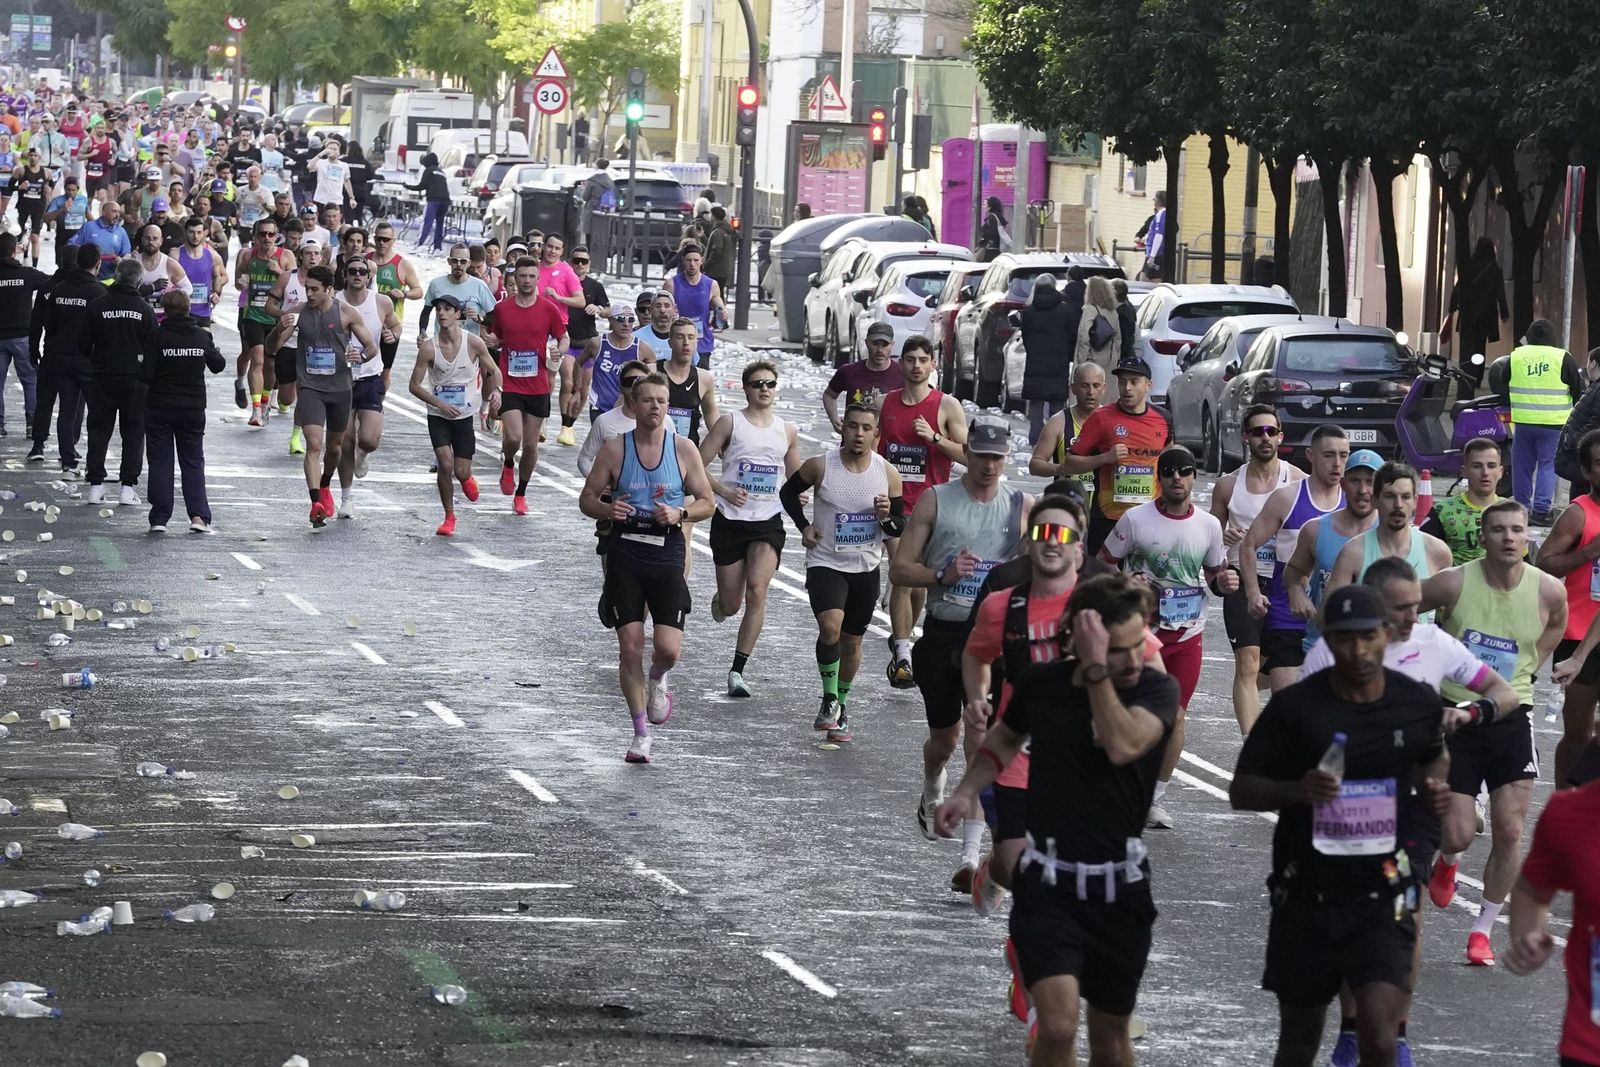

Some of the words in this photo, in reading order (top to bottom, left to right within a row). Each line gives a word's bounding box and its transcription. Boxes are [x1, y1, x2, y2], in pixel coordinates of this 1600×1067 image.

[540, 90, 561, 103] 30
[0, 278, 25, 287] UNTEER
[55, 296, 87, 307] VOLUNTEER
[102, 310, 143, 321] VOLUNTEER
[162, 348, 205, 357] VOLUNTEER
[1527, 362, 1550, 377] Life
[1354, 431, 1374, 441] GBR
[1478, 427, 1497, 436] cabify
[899, 446, 923, 454] ZURICH
[736, 482, 752, 492] SAM
[753, 483, 777, 494] MACEY
[1117, 485, 1151, 495] CHARLES
[1176, 588, 1200, 597] ZURICH
[1483, 638, 1513, 650] ZURICH
[1341, 784, 1387, 796] ZURICH
[1315, 819, 1395, 836] FERNANDO
